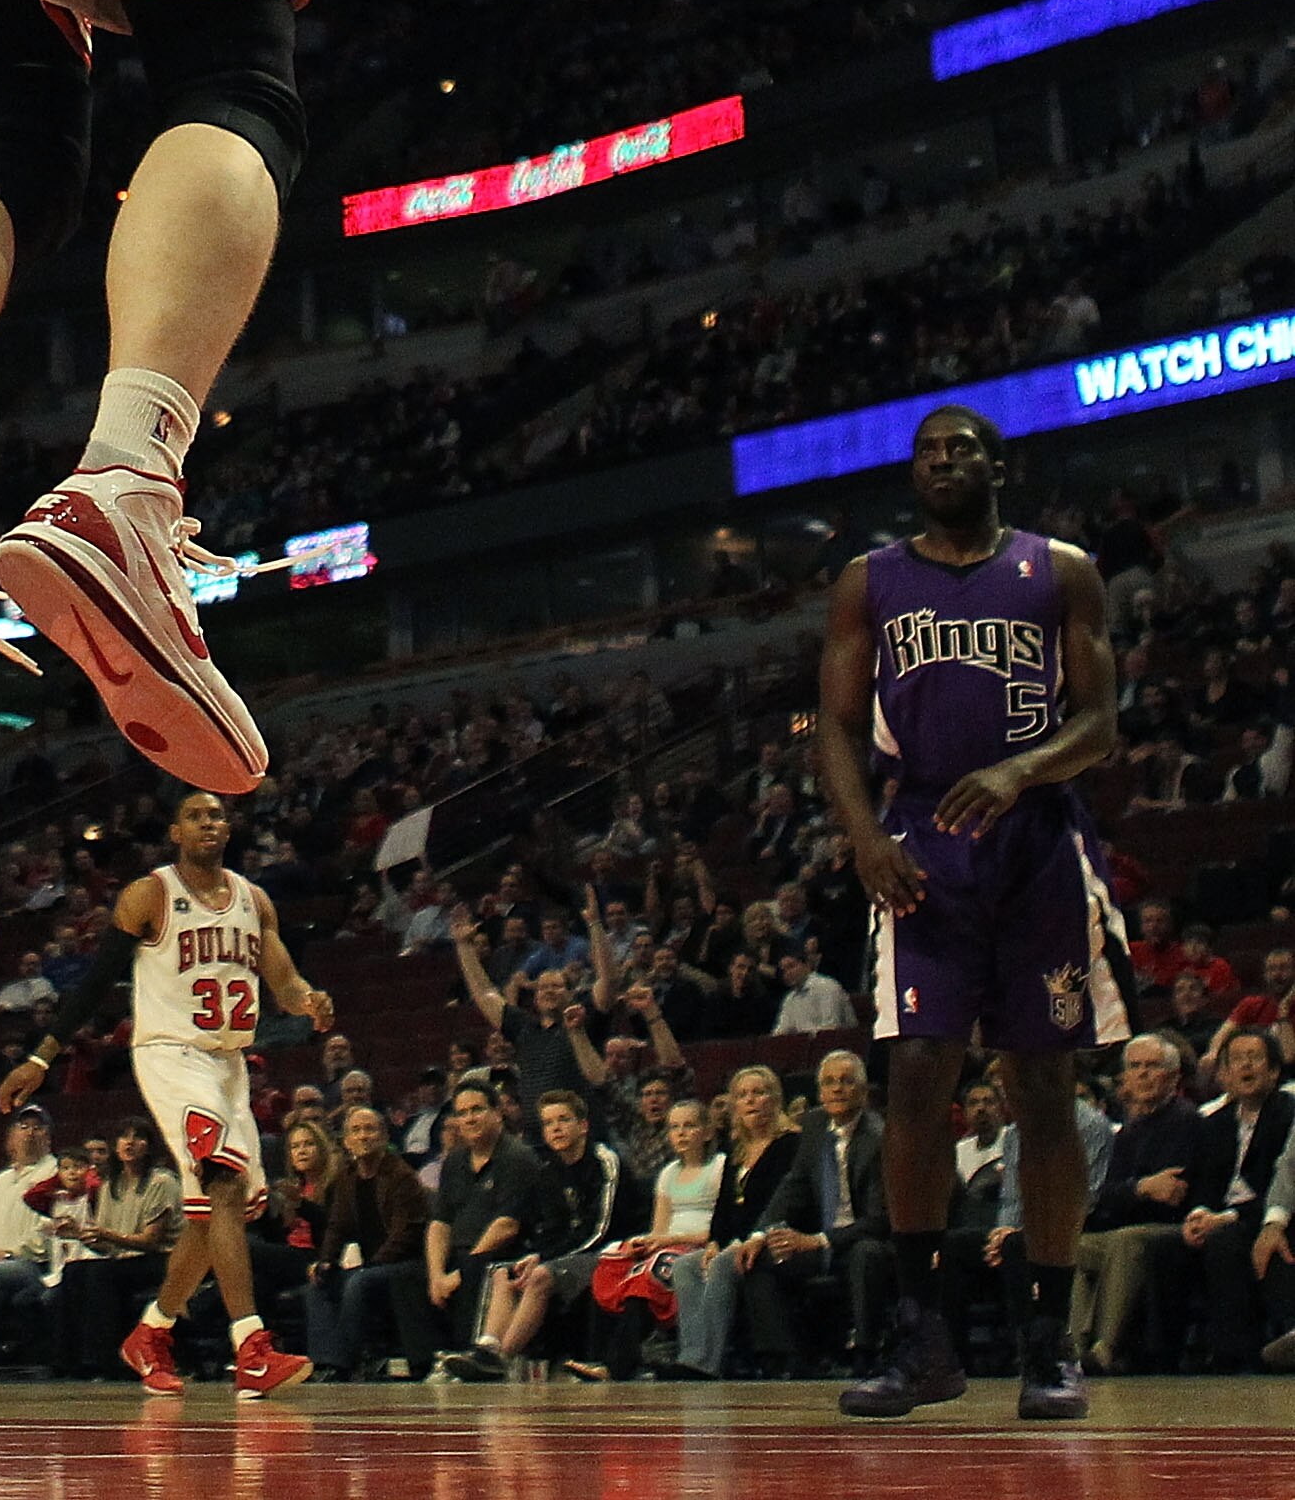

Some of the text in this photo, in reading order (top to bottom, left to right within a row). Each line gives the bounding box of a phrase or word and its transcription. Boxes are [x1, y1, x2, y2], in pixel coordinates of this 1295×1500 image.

[1074, 315, 1295, 406] WATCH CHI
[884, 608, 1045, 680] Kings
[1006, 681, 1049, 742] 5
[178, 926, 261, 976] BULLS
[192, 978, 257, 1031] 32
